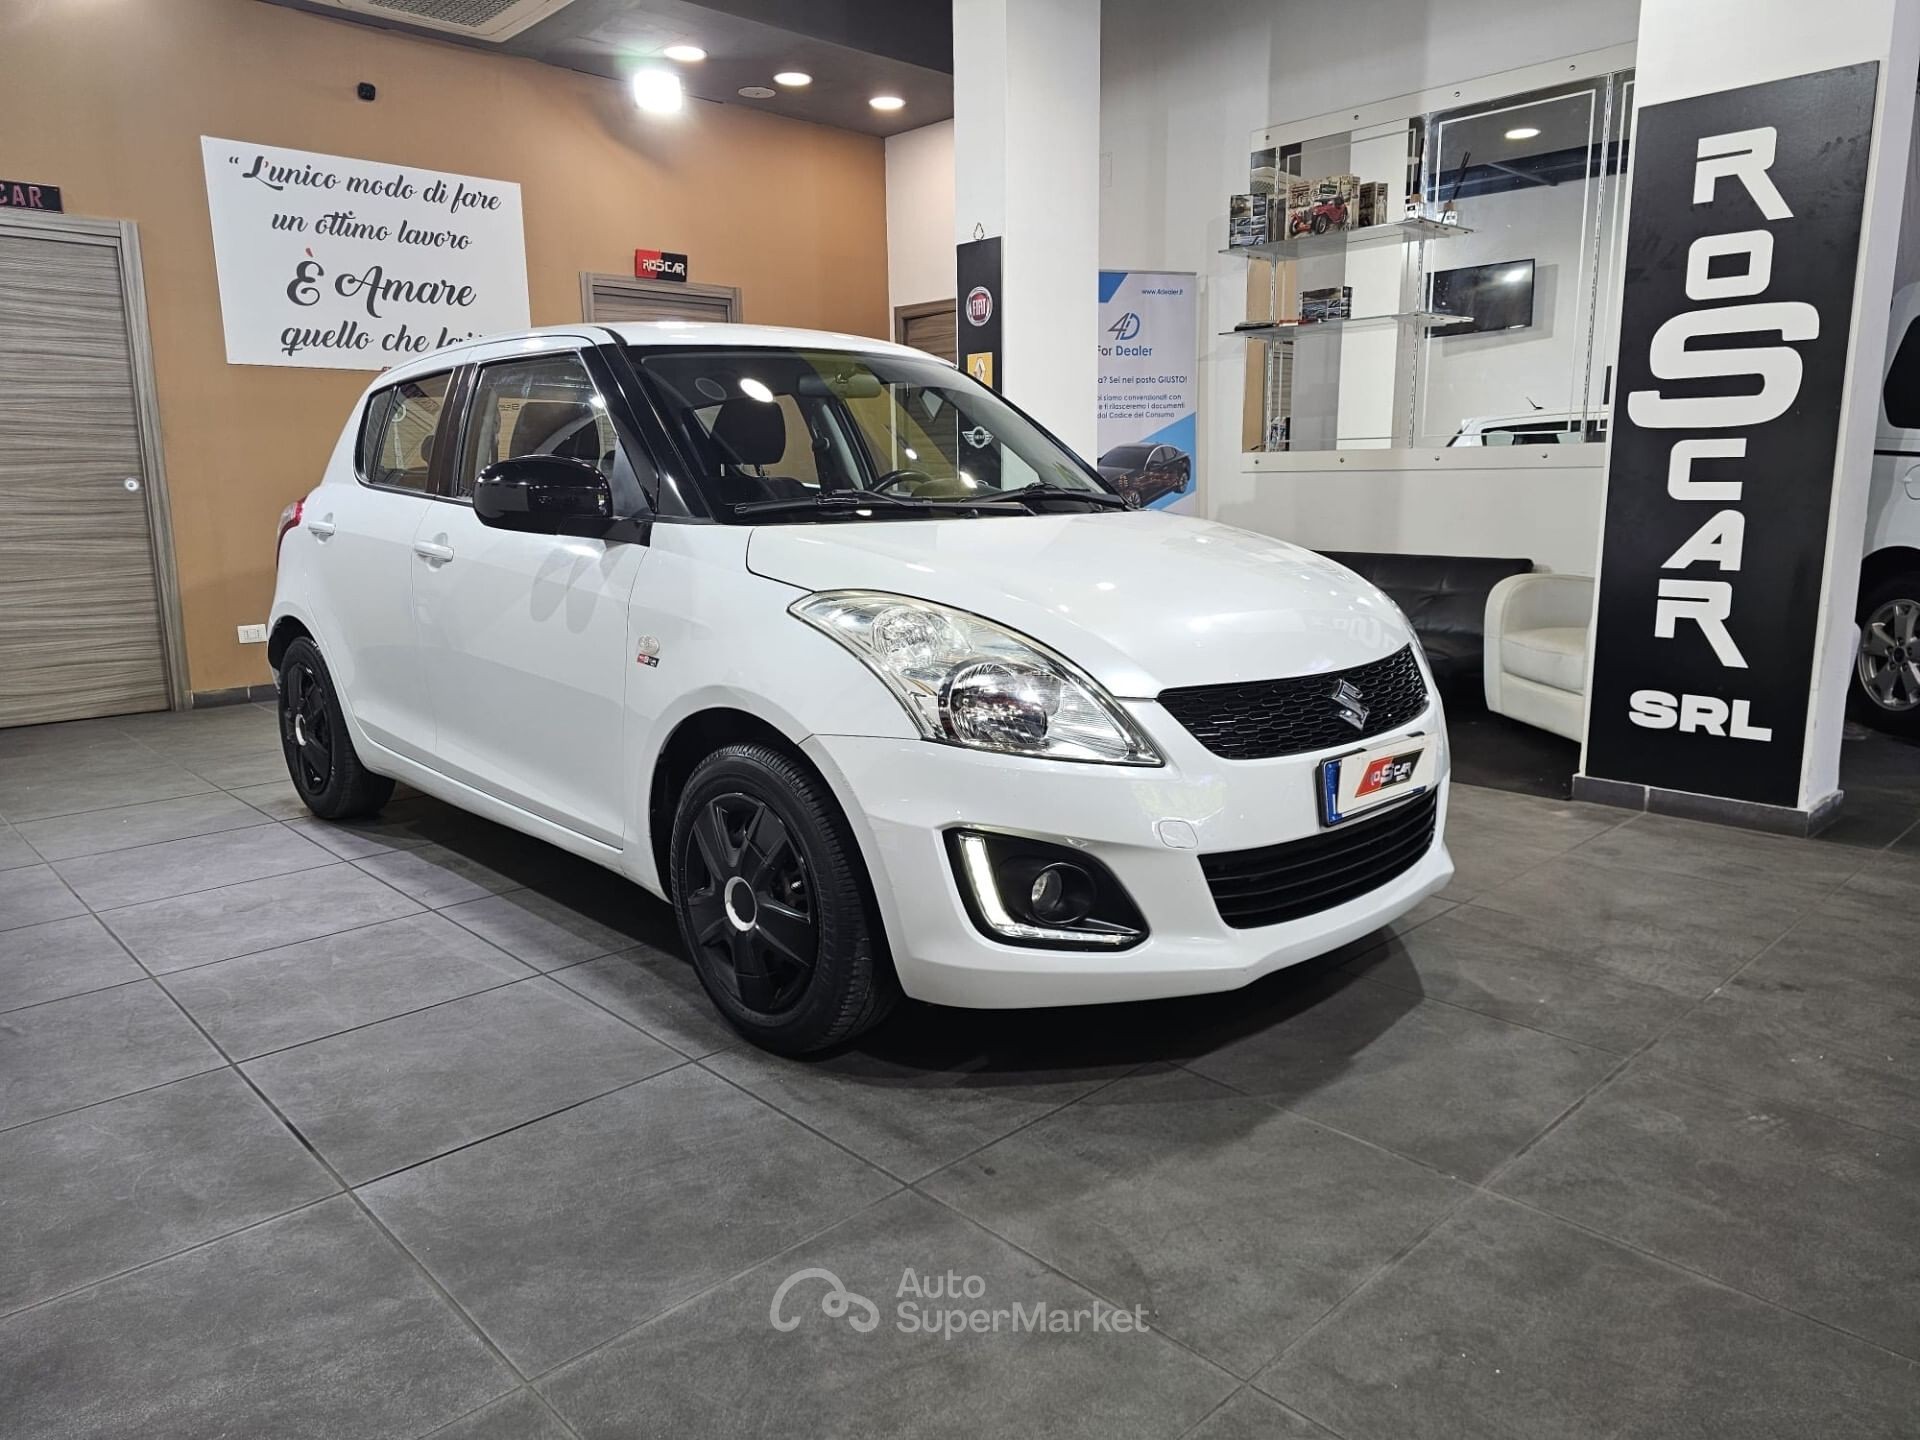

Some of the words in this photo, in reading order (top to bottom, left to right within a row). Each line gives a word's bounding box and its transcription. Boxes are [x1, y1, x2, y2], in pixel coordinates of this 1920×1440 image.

[346, 174, 418, 200] modo
[423, 179, 449, 204] di
[444, 183, 502, 214] fare
[271, 213, 308, 233] un
[315, 210, 392, 241] ottimo
[398, 220, 473, 250] lavoro
[286, 247, 325, 307] È
[334, 265, 477, 318] Amare
[280, 320, 374, 357] quello
[381, 323, 430, 353] che
[1115, 345, 1153, 357] Dealer
[1109, 375, 1121, 384] Sei
[1135, 376, 1156, 385] posto
[1158, 375, 1188, 384] GIUSTO!
[1628, 690, 1773, 743] SRL
